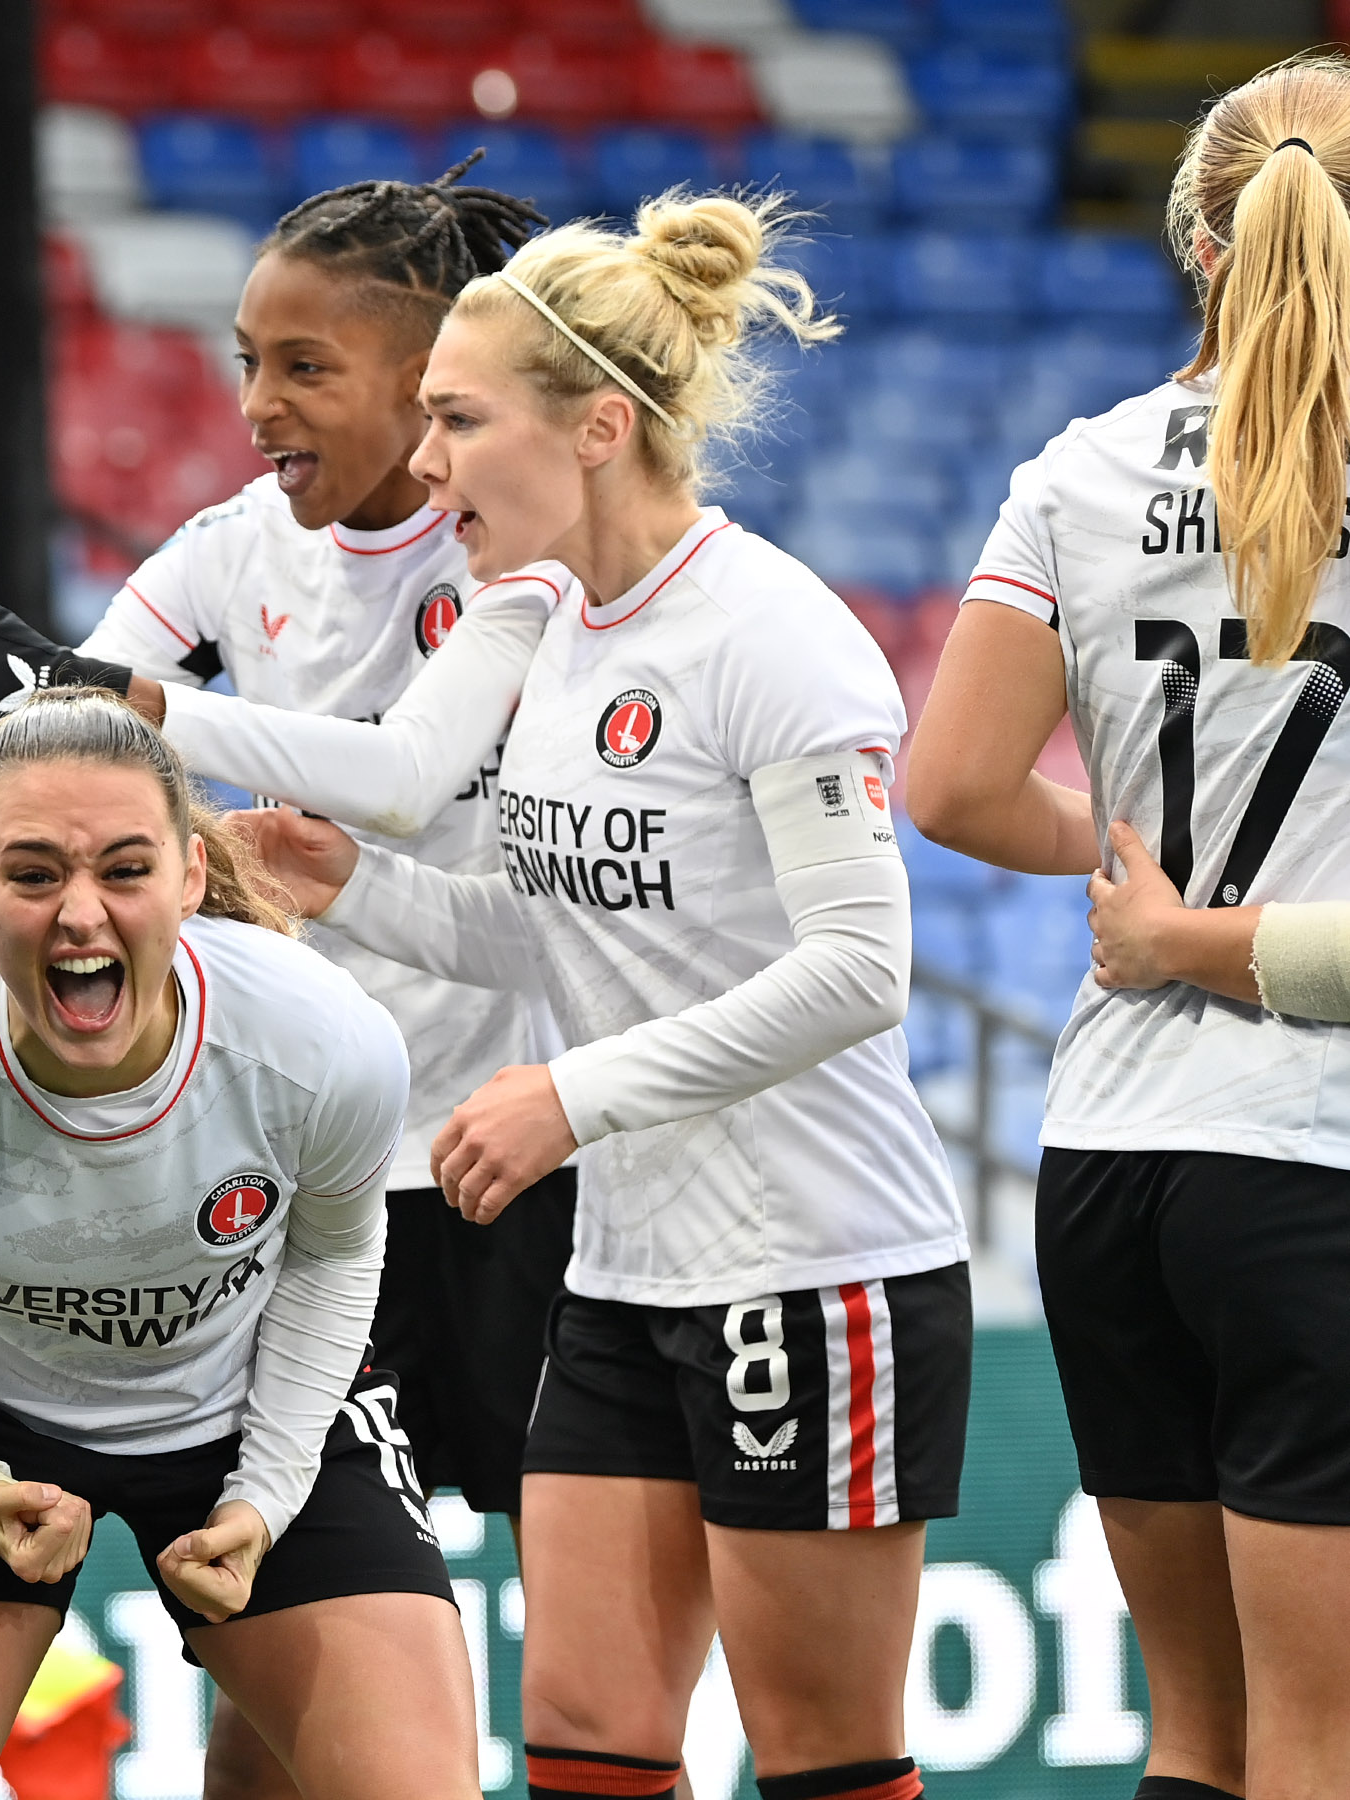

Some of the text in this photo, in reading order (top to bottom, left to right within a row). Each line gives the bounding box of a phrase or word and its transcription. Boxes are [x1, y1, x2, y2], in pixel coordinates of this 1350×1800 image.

[614, 690, 659, 712] CHARLTON
[601, 749, 639, 768] ATHLETIC
[1134, 618, 1350, 910] 17
[499, 788, 667, 854] ERSITY OF
[210, 1176, 268, 1201] CHARLTON
[214, 1222, 259, 1244] ATHLETIC
[723, 1293, 791, 1412] 8
[733, 1459, 798, 1472] CASTORE
